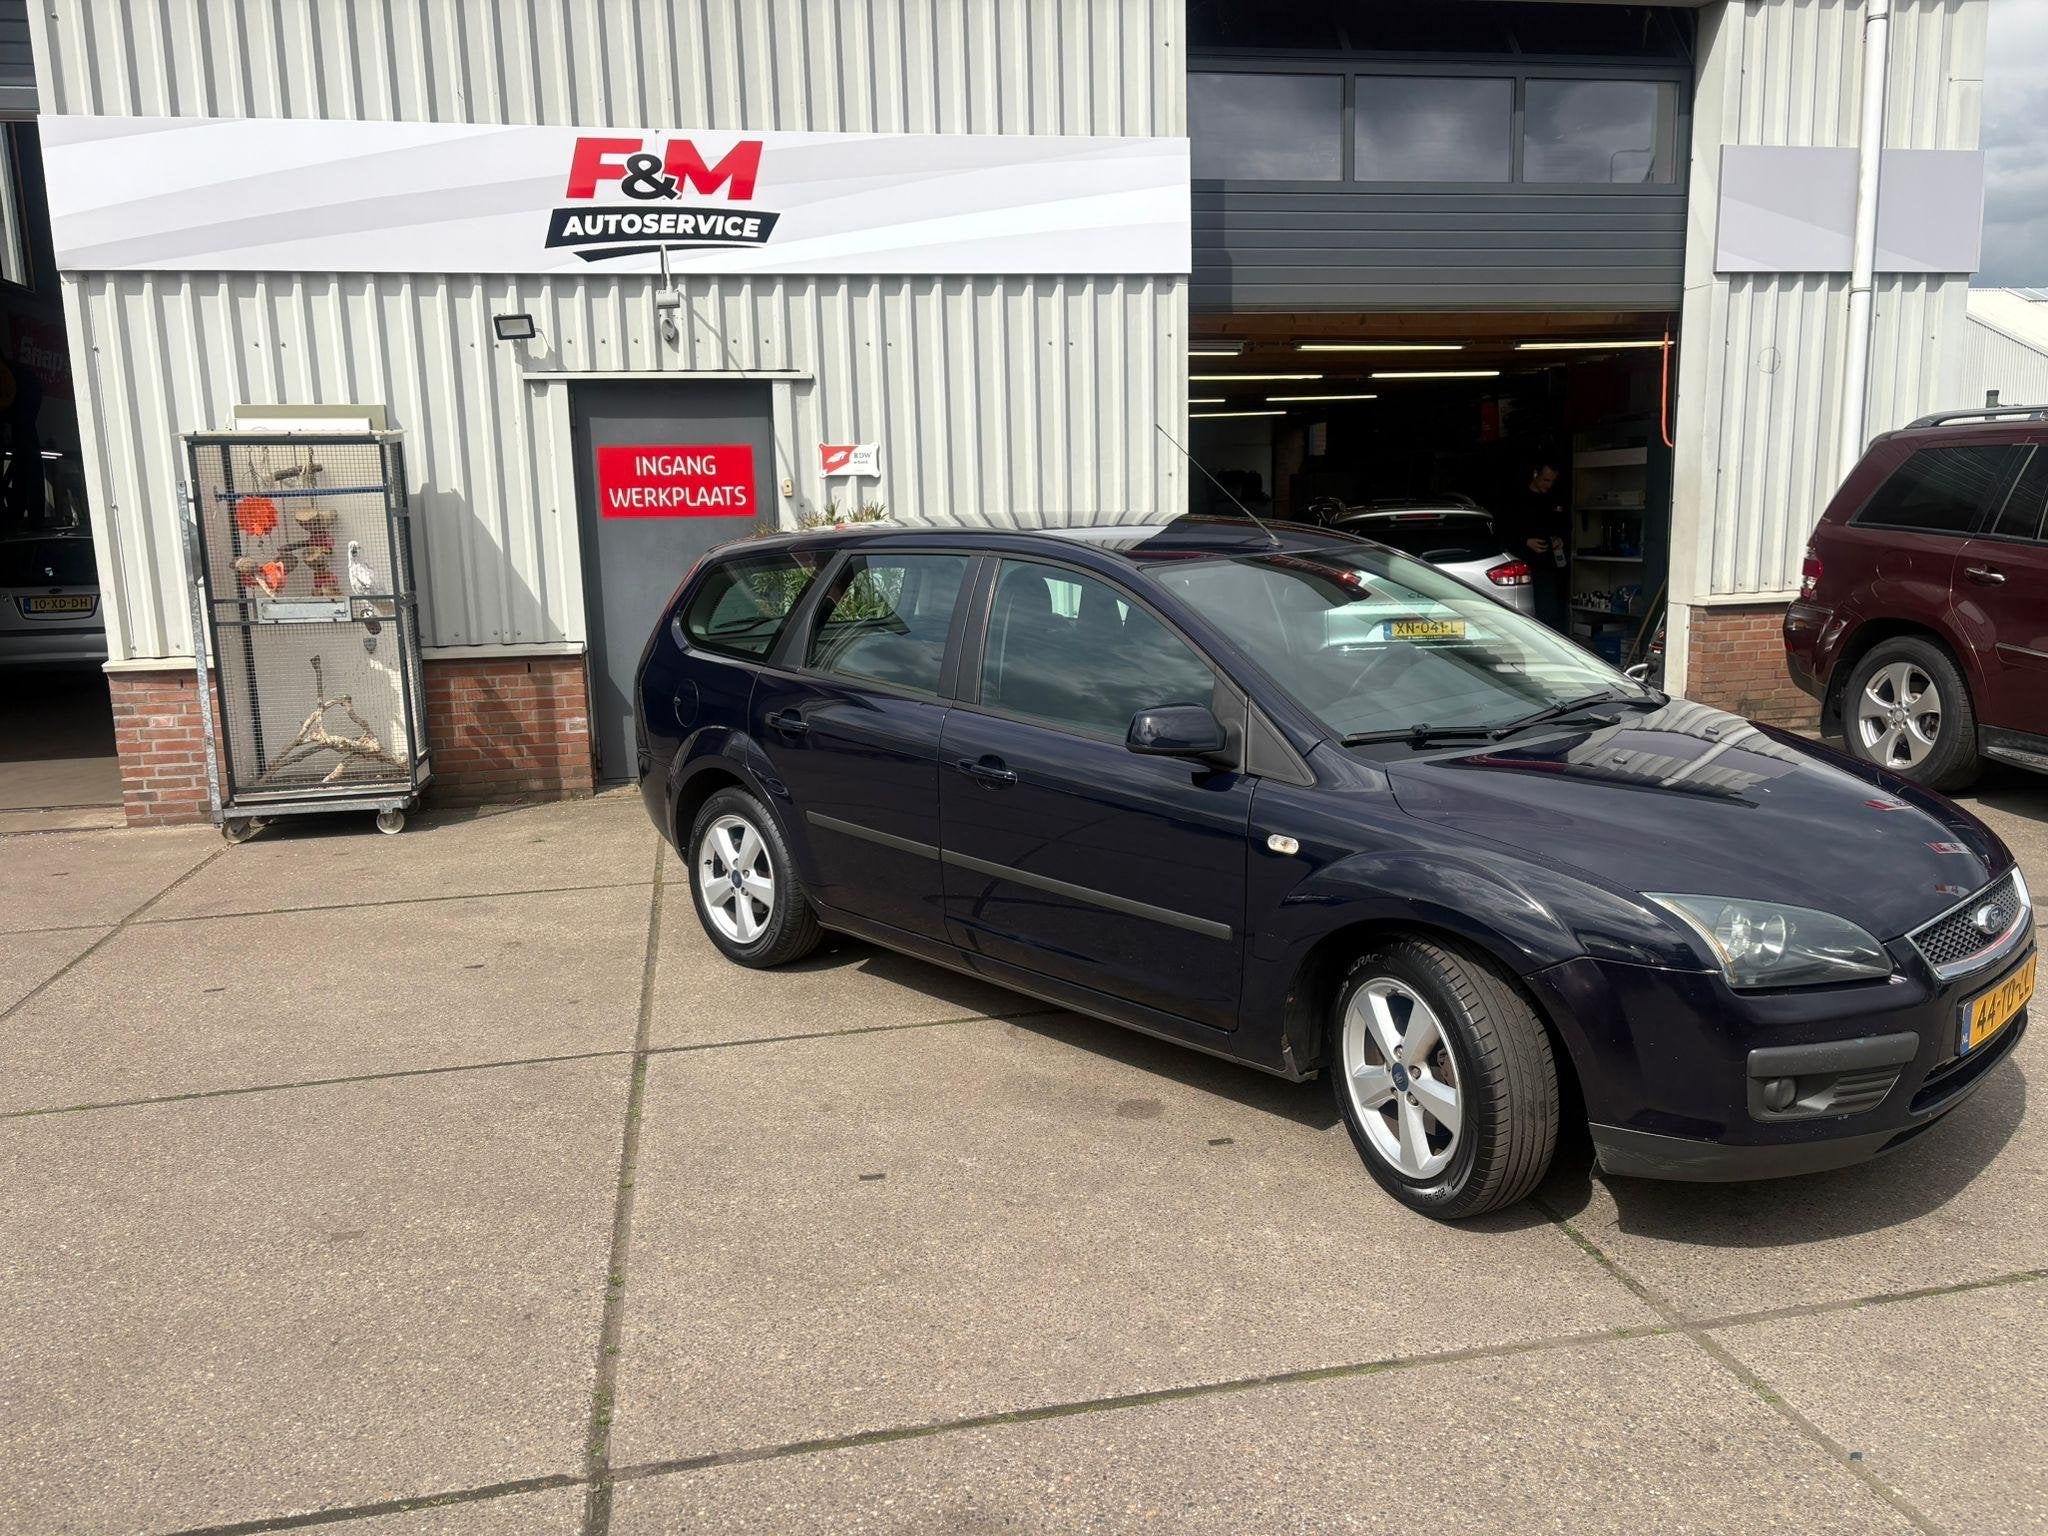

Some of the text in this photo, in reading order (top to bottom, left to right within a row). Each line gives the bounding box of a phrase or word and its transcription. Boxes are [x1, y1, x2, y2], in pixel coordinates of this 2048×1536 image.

[566, 137, 763, 201] F&M
[562, 213, 761, 239] AUTOSERVICE
[635, 455, 717, 477] INGANG
[609, 485, 747, 509] WERKPLAATS
[34, 598, 88, 609] 10-XD-DH
[1396, 621, 1458, 634] XN-041-L
